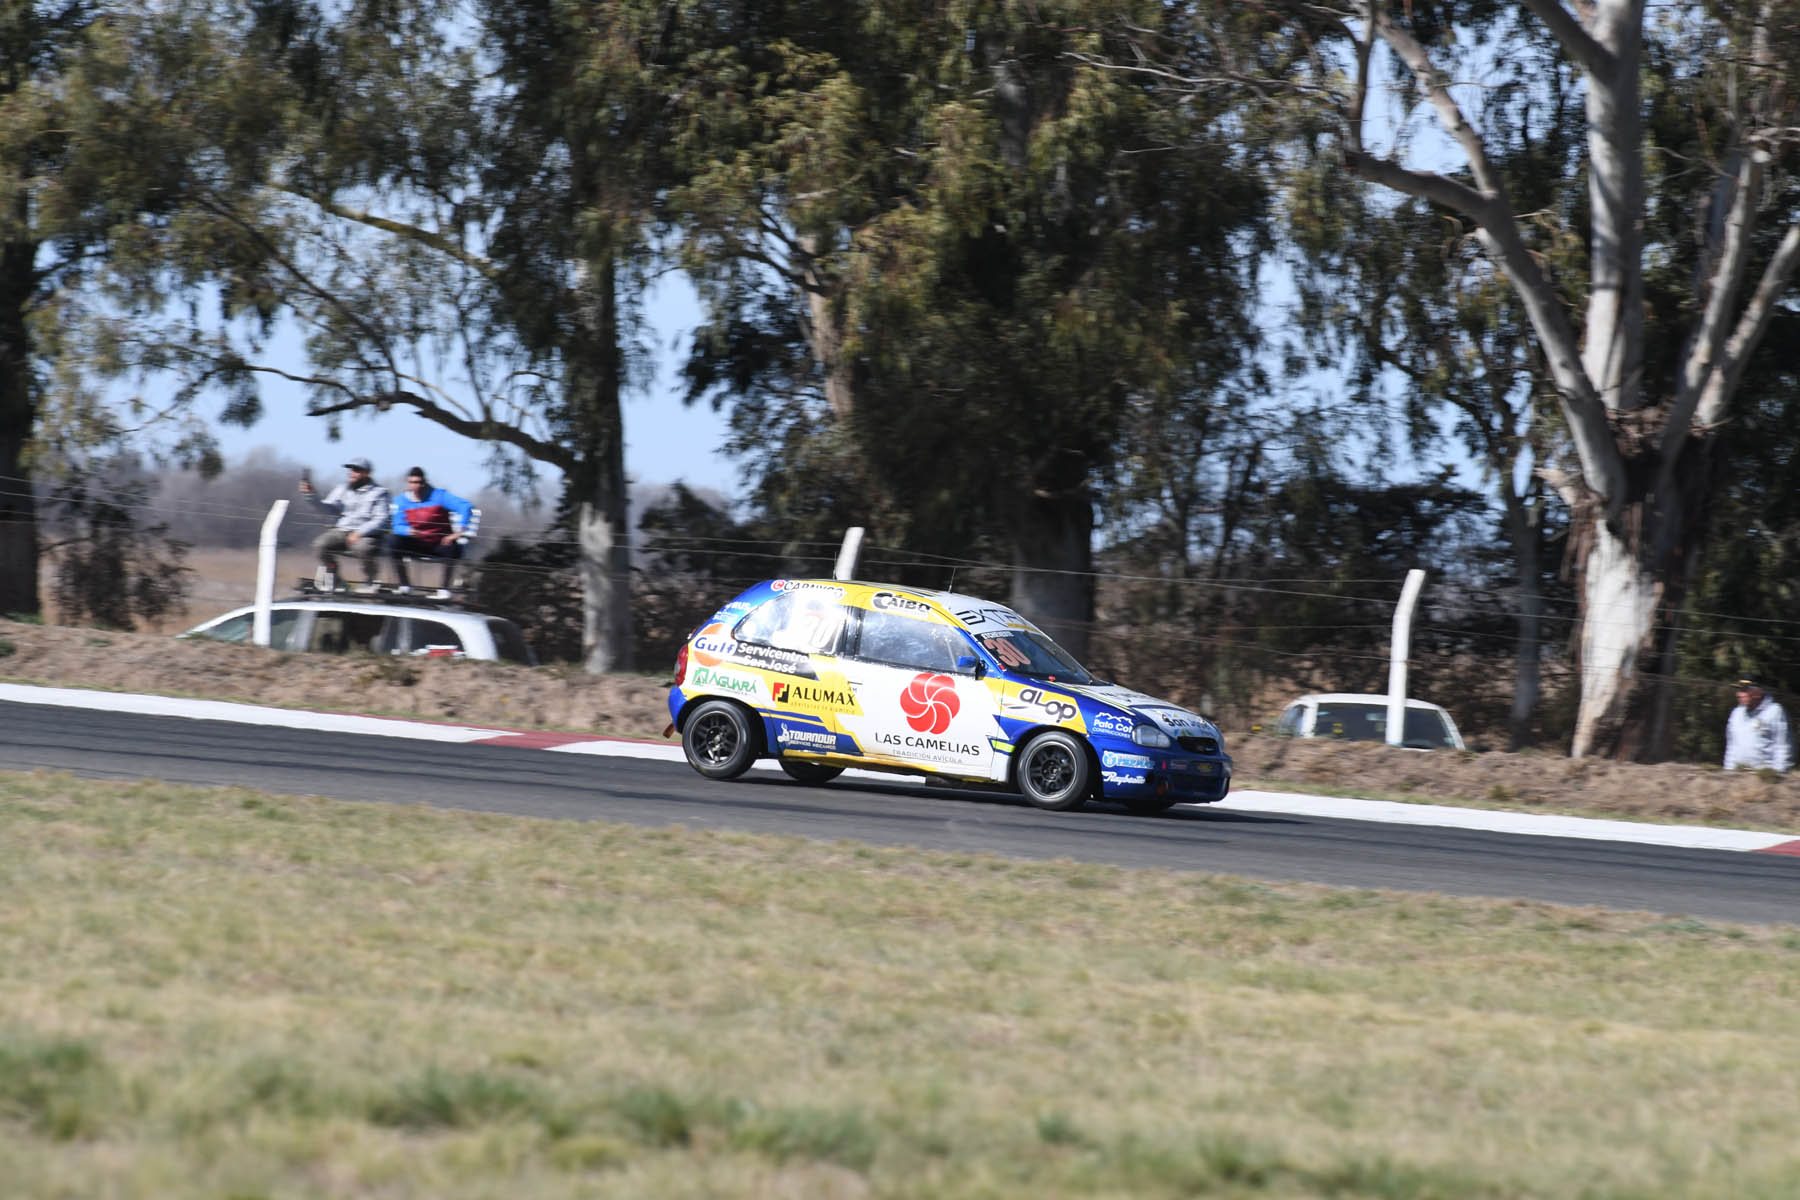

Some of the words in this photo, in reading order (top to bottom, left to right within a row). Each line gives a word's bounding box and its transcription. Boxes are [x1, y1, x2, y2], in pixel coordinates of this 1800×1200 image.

[694, 637, 735, 653] Gulf
[738, 642, 810, 662] Servicentro
[984, 638, 1031, 667] 30
[766, 660, 797, 674] José
[792, 686, 855, 706] ALUMAX
[874, 732, 902, 746] LAS
[905, 736, 980, 756] CAMELIAS
